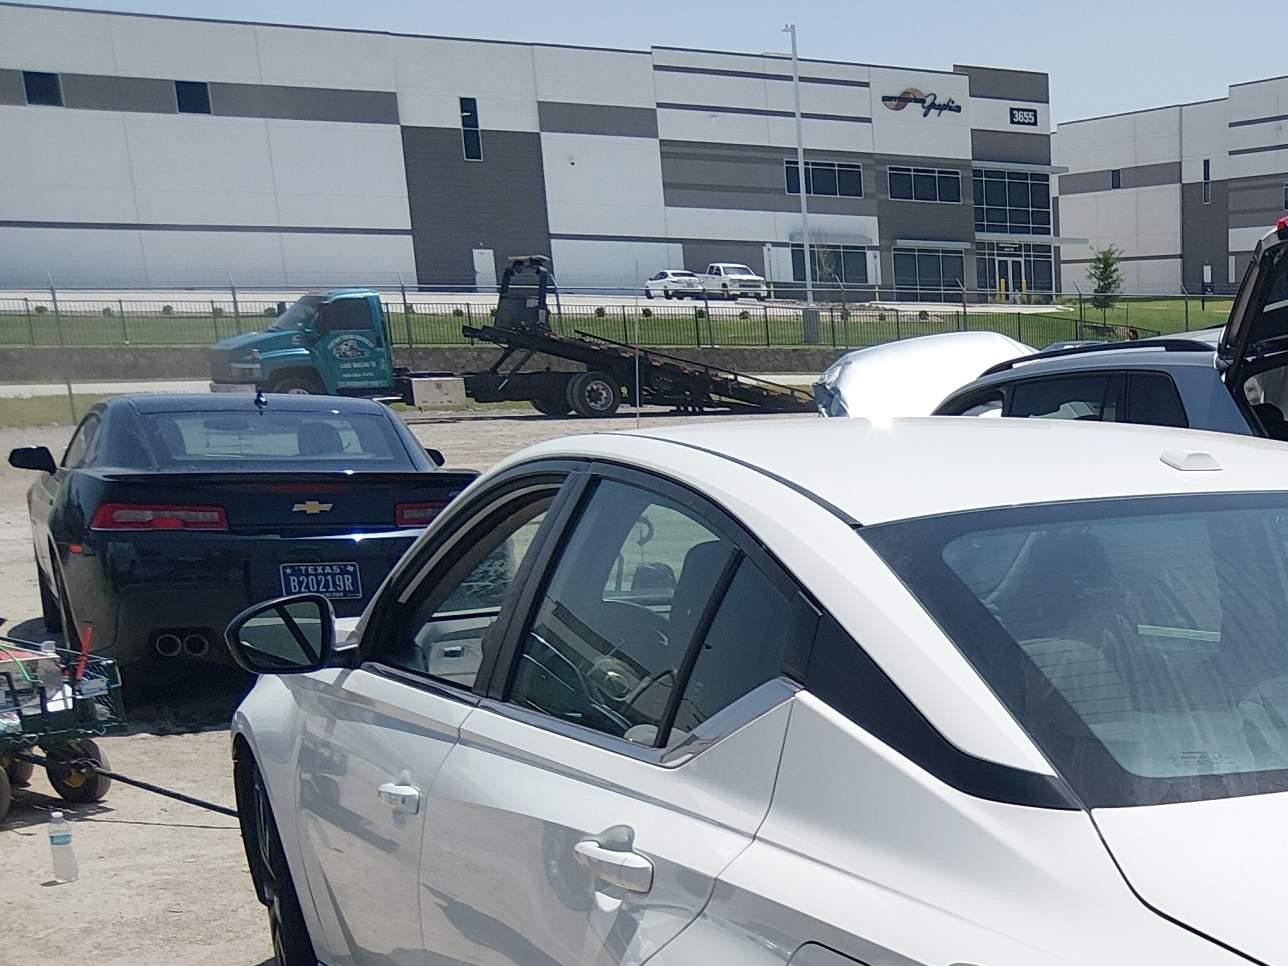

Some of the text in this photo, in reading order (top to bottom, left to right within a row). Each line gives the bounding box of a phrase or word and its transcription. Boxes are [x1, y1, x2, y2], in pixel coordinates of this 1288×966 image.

[1012, 110, 1035, 123] 3655
[300, 565, 341, 575] TEXAS
[289, 574, 354, 593] B20219R
